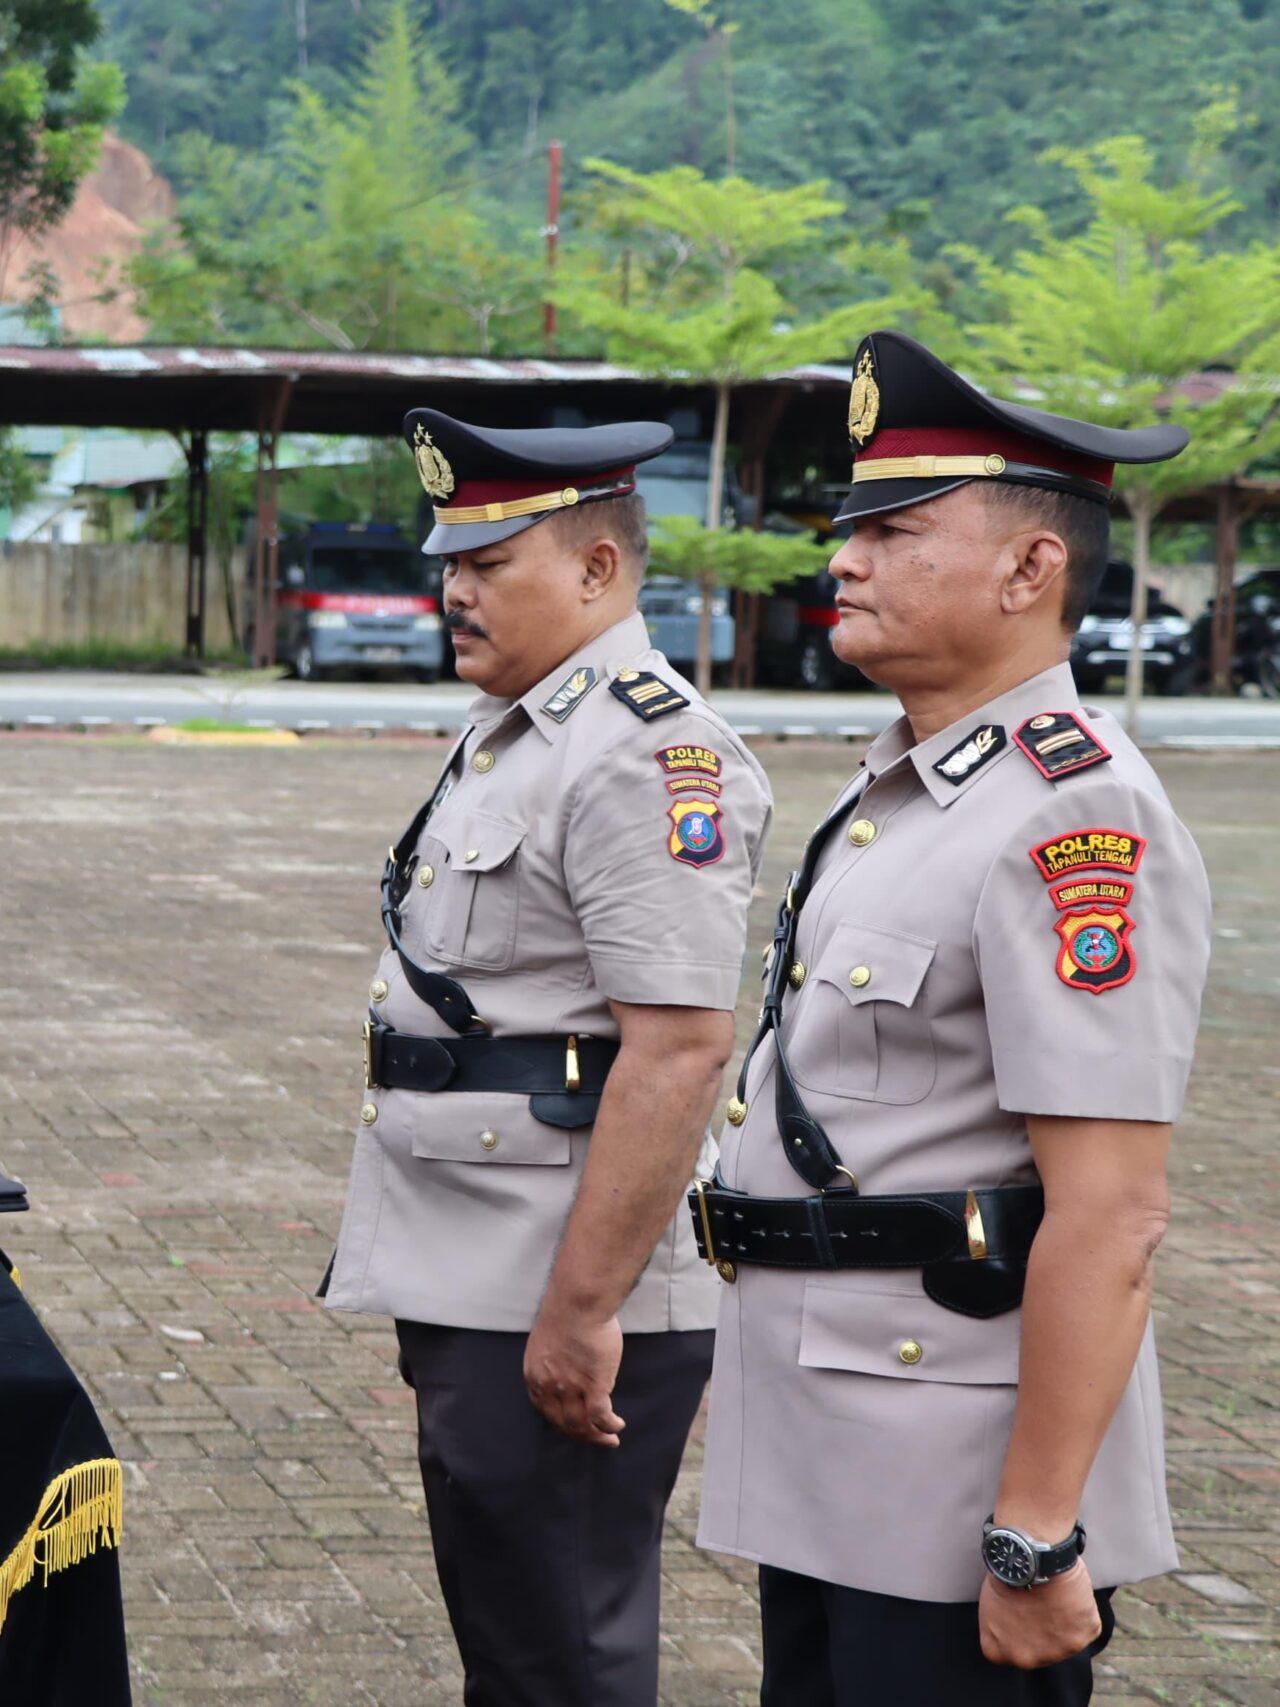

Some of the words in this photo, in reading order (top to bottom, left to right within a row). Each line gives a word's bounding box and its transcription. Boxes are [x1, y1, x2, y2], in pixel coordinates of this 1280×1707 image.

[666, 747, 716, 763] POLRES
[1045, 834, 1131, 862] POLRES
[1047, 851, 1092, 873] TAPANULI
[1094, 850, 1132, 867] TENGAH
[1059, 884, 1098, 902] SUMATERA
[1100, 884, 1125, 899] UTARA
